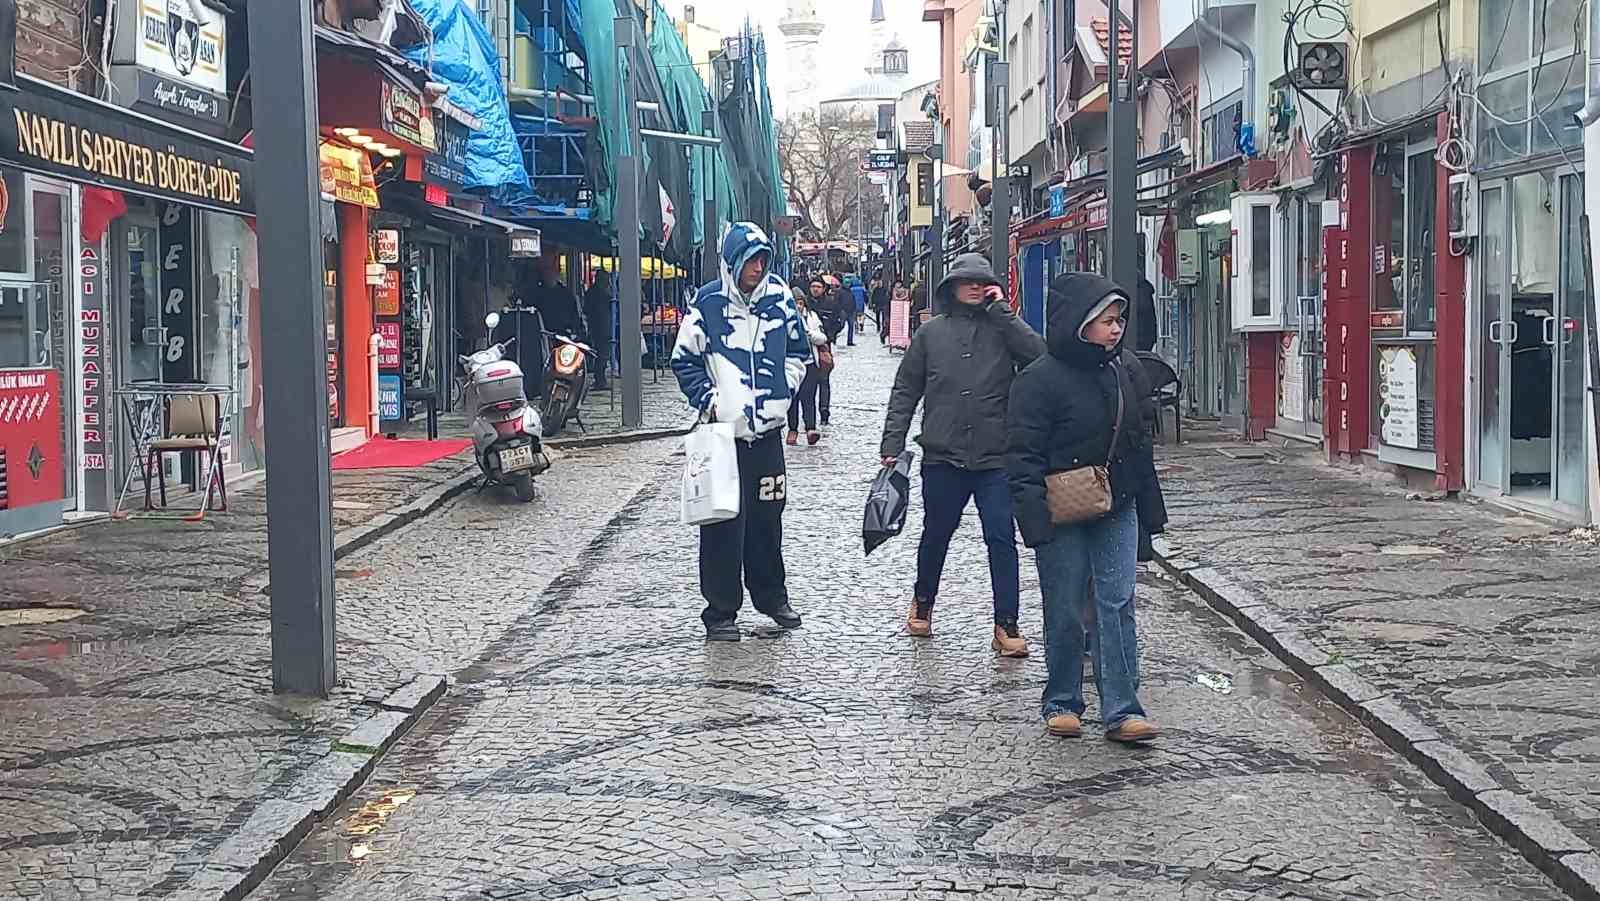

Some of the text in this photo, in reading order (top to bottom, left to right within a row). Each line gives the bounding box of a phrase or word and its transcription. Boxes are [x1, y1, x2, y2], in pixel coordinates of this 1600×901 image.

[199, 39, 216, 65] ASAN
[13, 107, 241, 205] NAMLI SARIYER BÖREK-PİDE
[79, 236, 98, 294] ACI
[80, 309, 102, 443] MUZAFFER
[759, 474, 786, 501] 23
